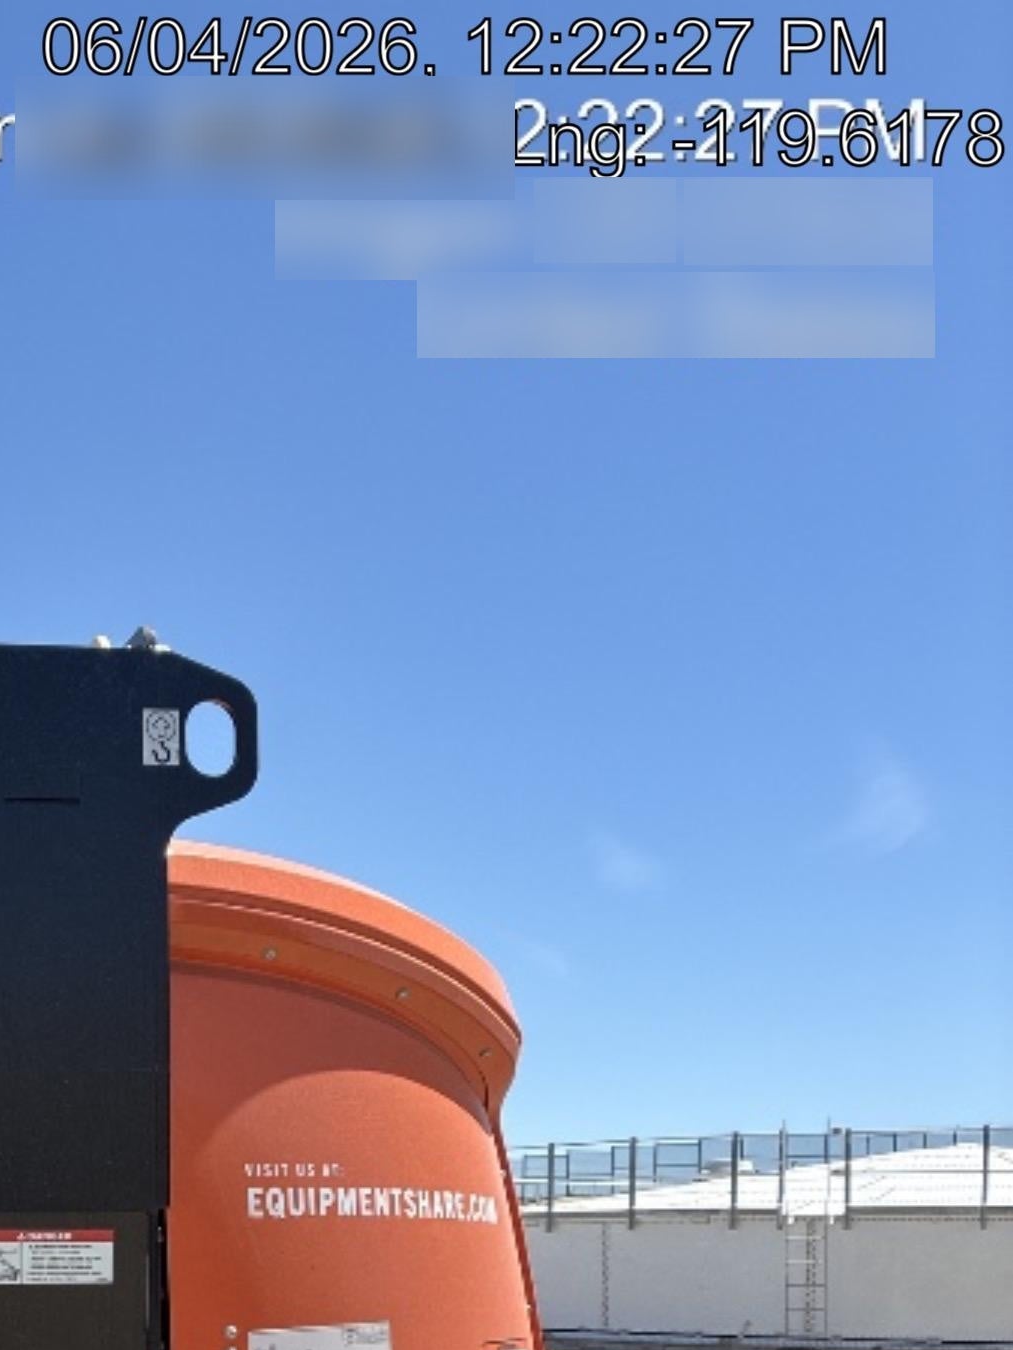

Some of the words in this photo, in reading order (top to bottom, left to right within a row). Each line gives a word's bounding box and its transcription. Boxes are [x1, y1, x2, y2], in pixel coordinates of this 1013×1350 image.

[244, 1163, 288, 1177] VISIT
[295, 1163, 316, 1177] US
[247, 1187, 498, 1224] EQUIPMENTSHARE.COM
